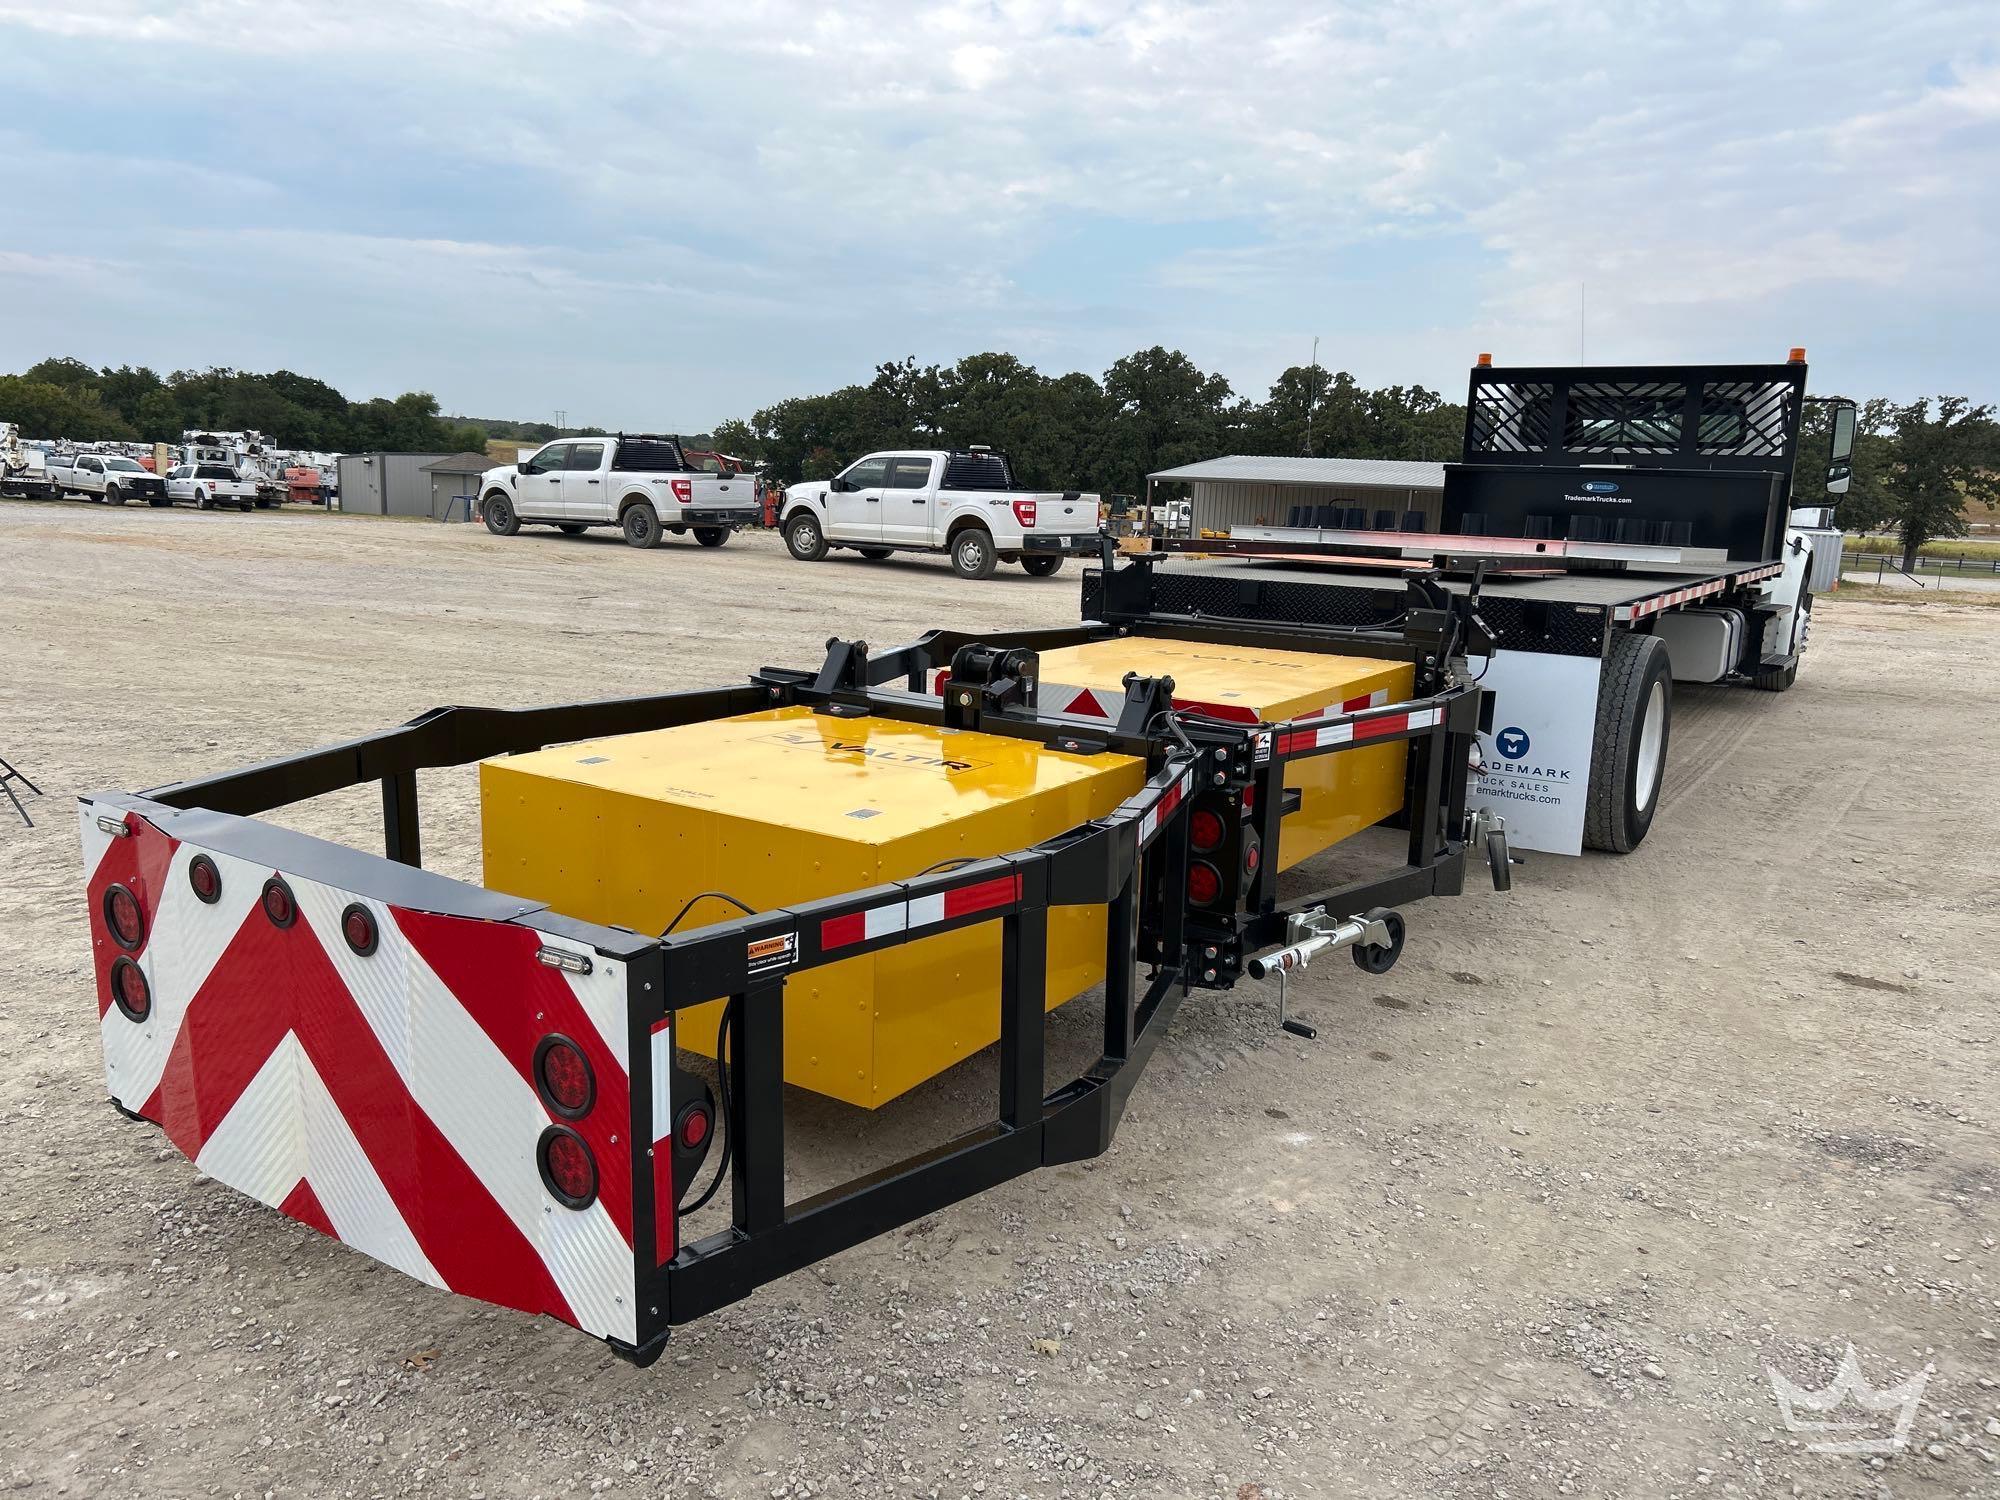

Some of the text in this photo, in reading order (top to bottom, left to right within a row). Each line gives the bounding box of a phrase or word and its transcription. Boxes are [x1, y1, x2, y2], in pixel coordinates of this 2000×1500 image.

[1564, 494, 1632, 504] TrademarkTrucks.com
[831, 742, 972, 771] VALTIR
[1479, 760, 1571, 780] ADEMARK
[1511, 780, 1549, 793] SALES
[754, 940, 784, 953] WARNING
